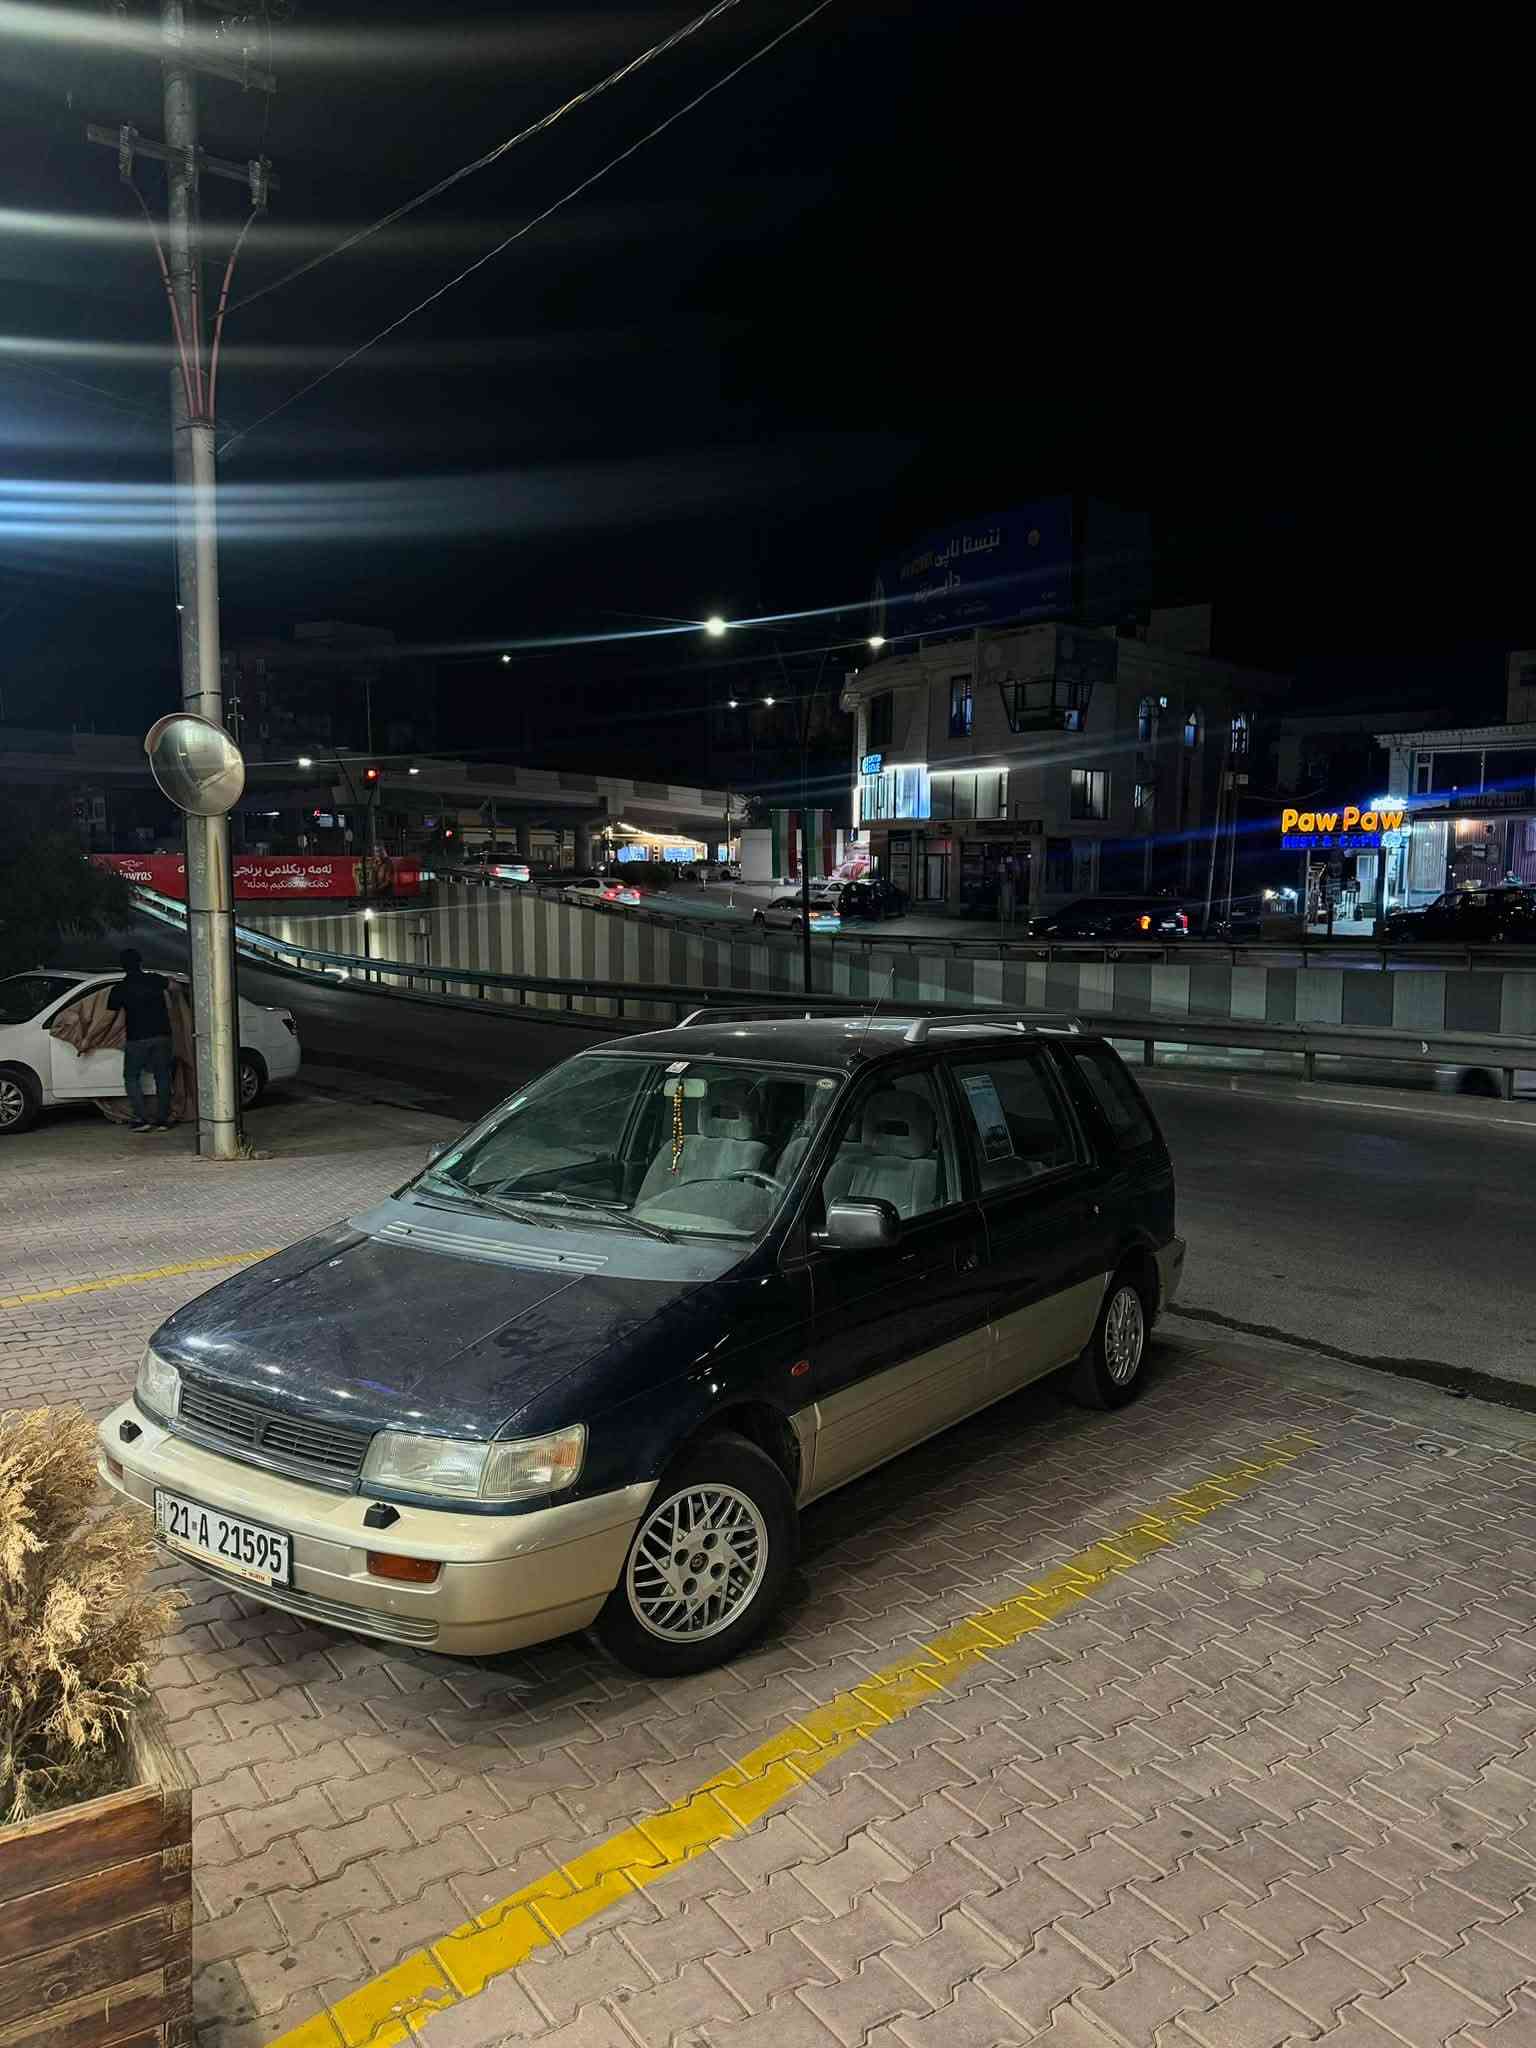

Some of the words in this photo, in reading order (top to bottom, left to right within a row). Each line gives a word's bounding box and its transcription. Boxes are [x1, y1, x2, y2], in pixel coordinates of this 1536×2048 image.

[1281, 808, 1338, 833] Paw
[1343, 806, 1404, 832] Paw
[169, 1501, 190, 1540] 21
[198, 1513, 209, 1549] A
[218, 1520, 282, 1573] 21595
